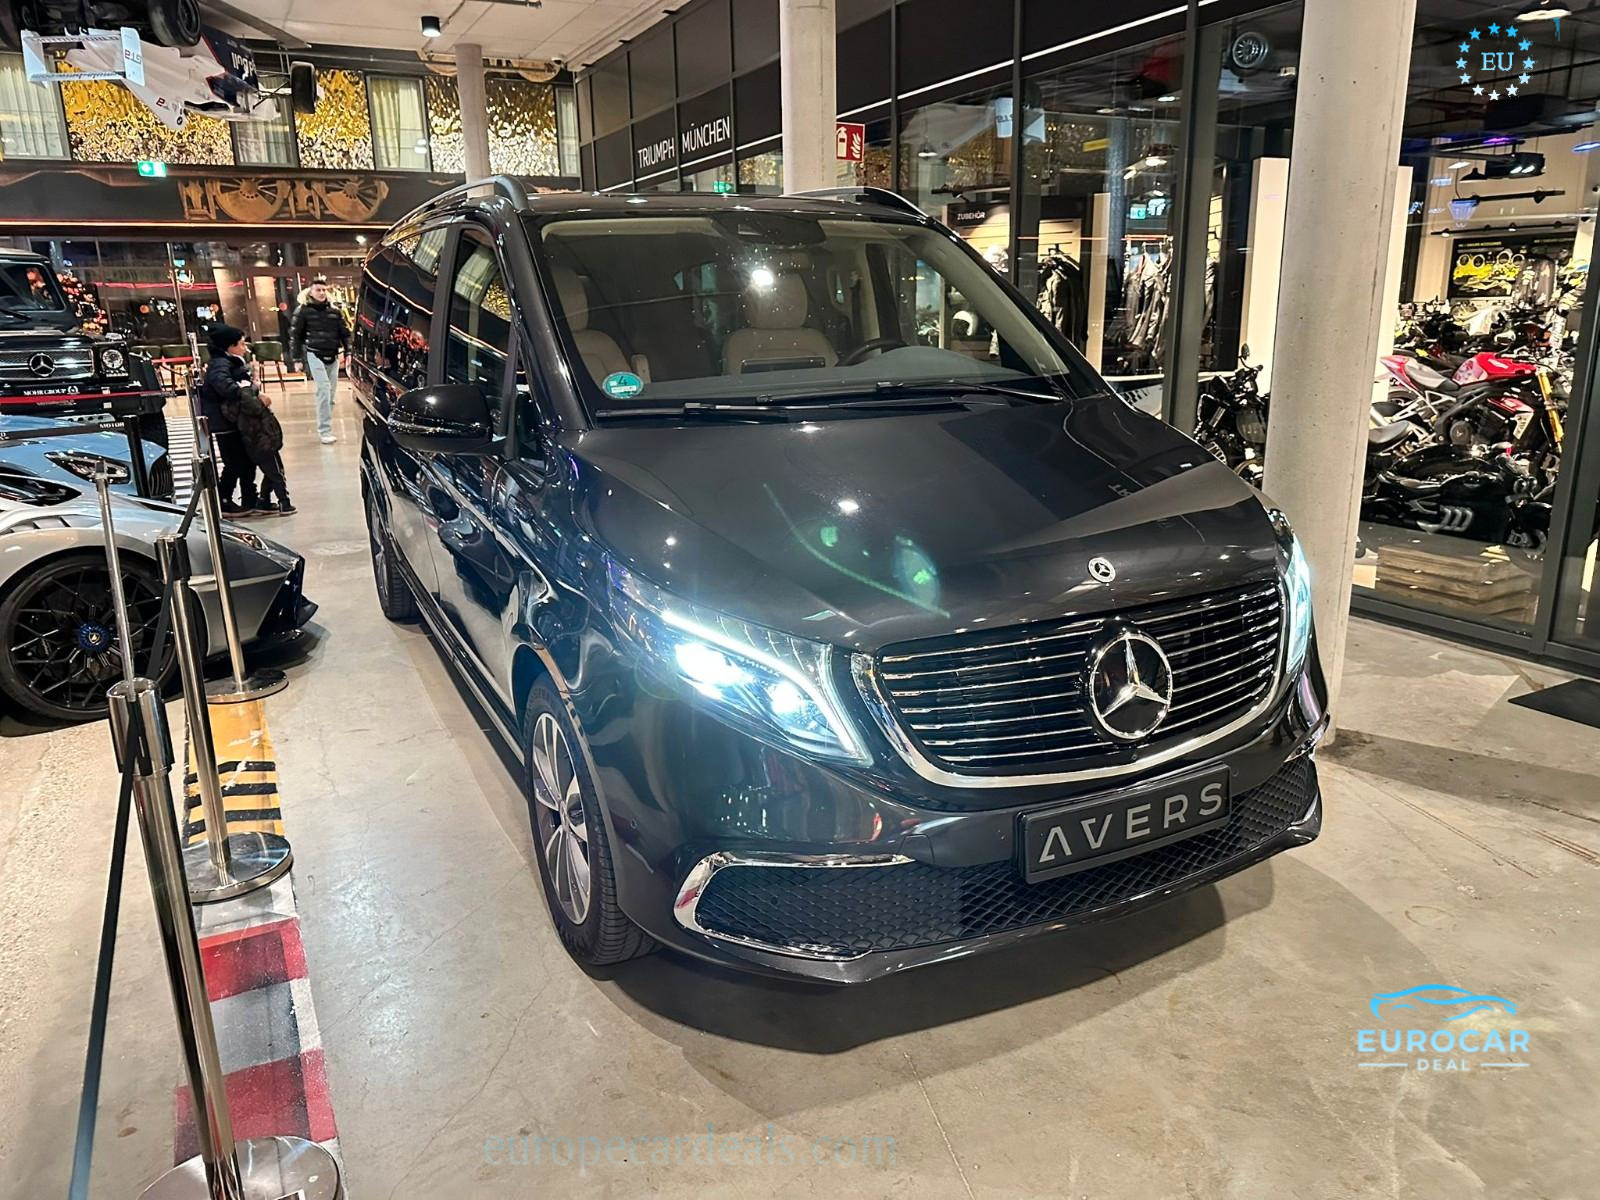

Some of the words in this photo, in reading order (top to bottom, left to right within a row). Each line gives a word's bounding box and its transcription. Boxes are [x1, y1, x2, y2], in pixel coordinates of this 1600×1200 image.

[637, 136, 675, 169] TRIUMPH
[681, 115, 731, 155] MÜNCHEN
[956, 210, 986, 221] ZUBEHÖR
[618, 375, 628, 387] 4
[99, 421, 125, 430] MOTOR
[1038, 782, 1223, 863] AVERS
